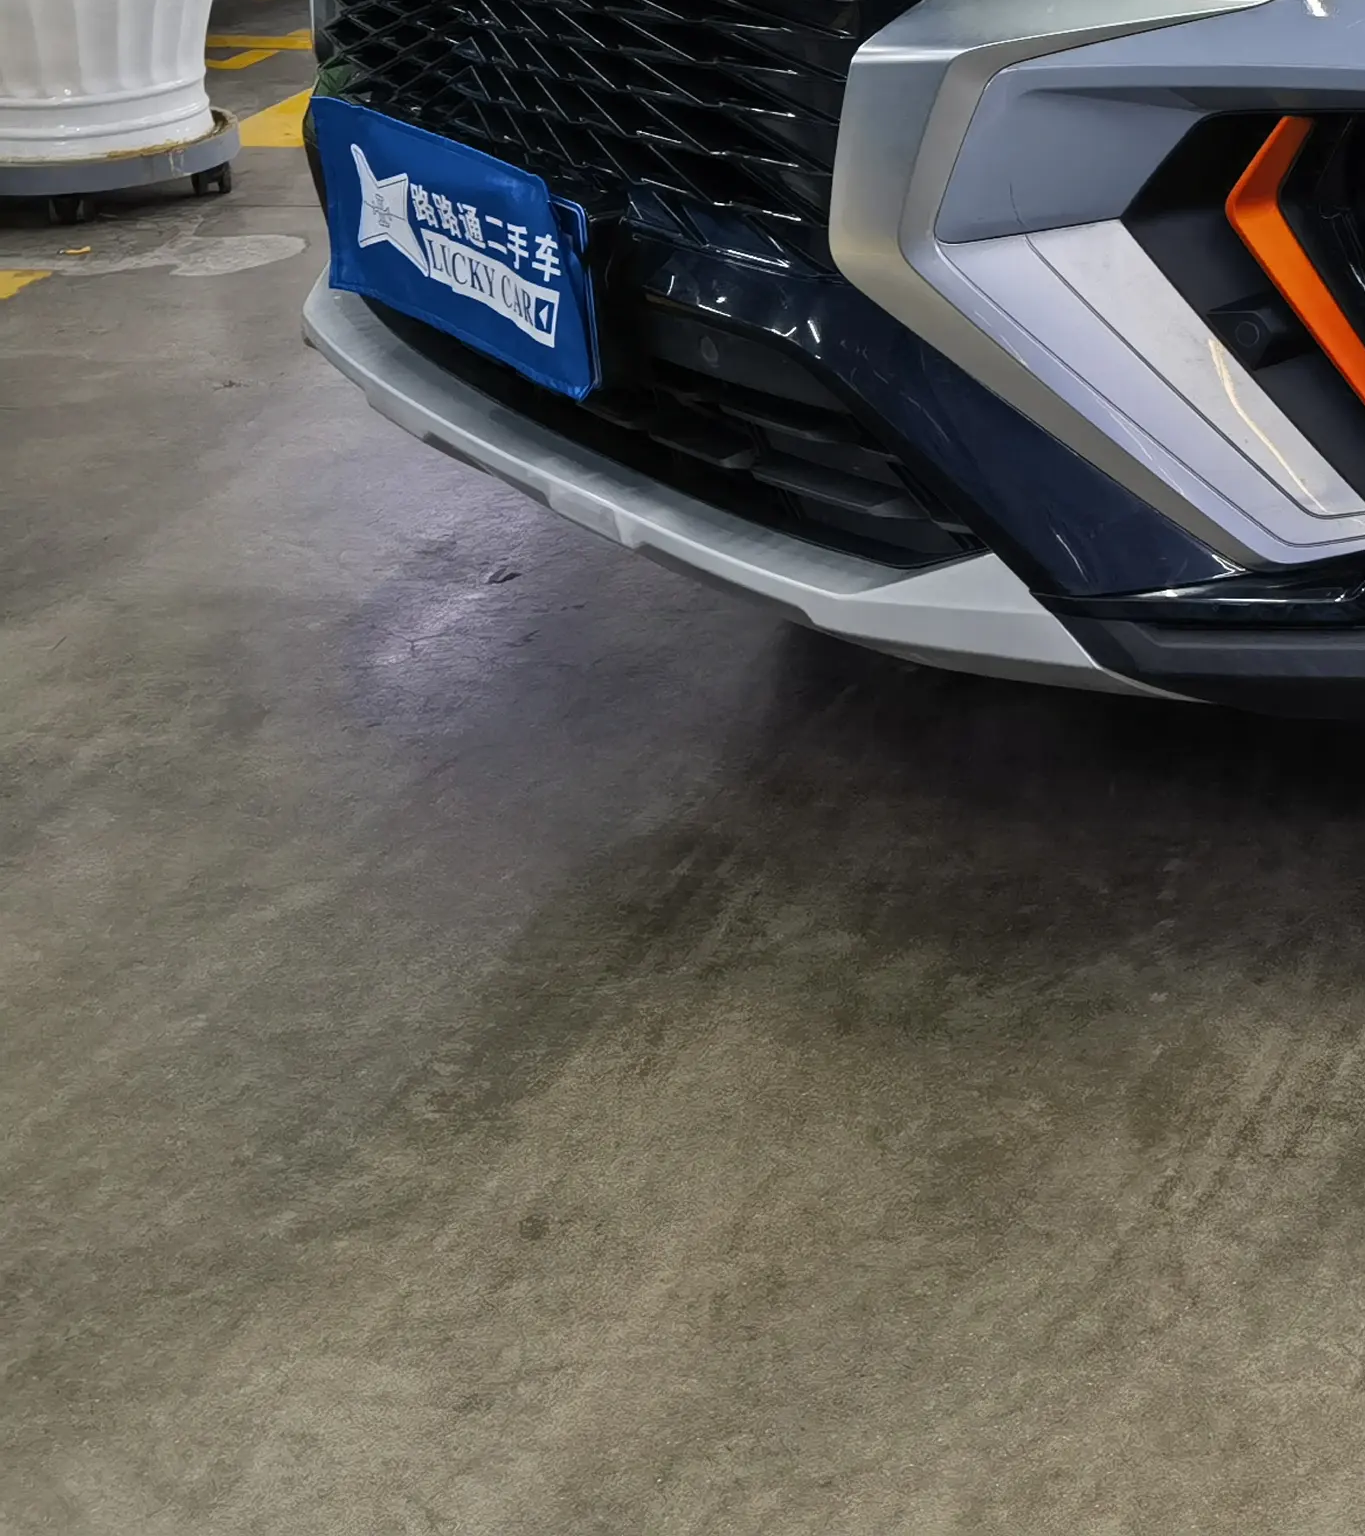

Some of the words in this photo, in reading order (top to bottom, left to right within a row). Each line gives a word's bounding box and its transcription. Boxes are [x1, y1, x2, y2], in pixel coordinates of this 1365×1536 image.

[409, 182, 562, 283] 路路通二手车
[426, 238, 496, 299] LUCKY
[501, 274, 535, 329] CAR
